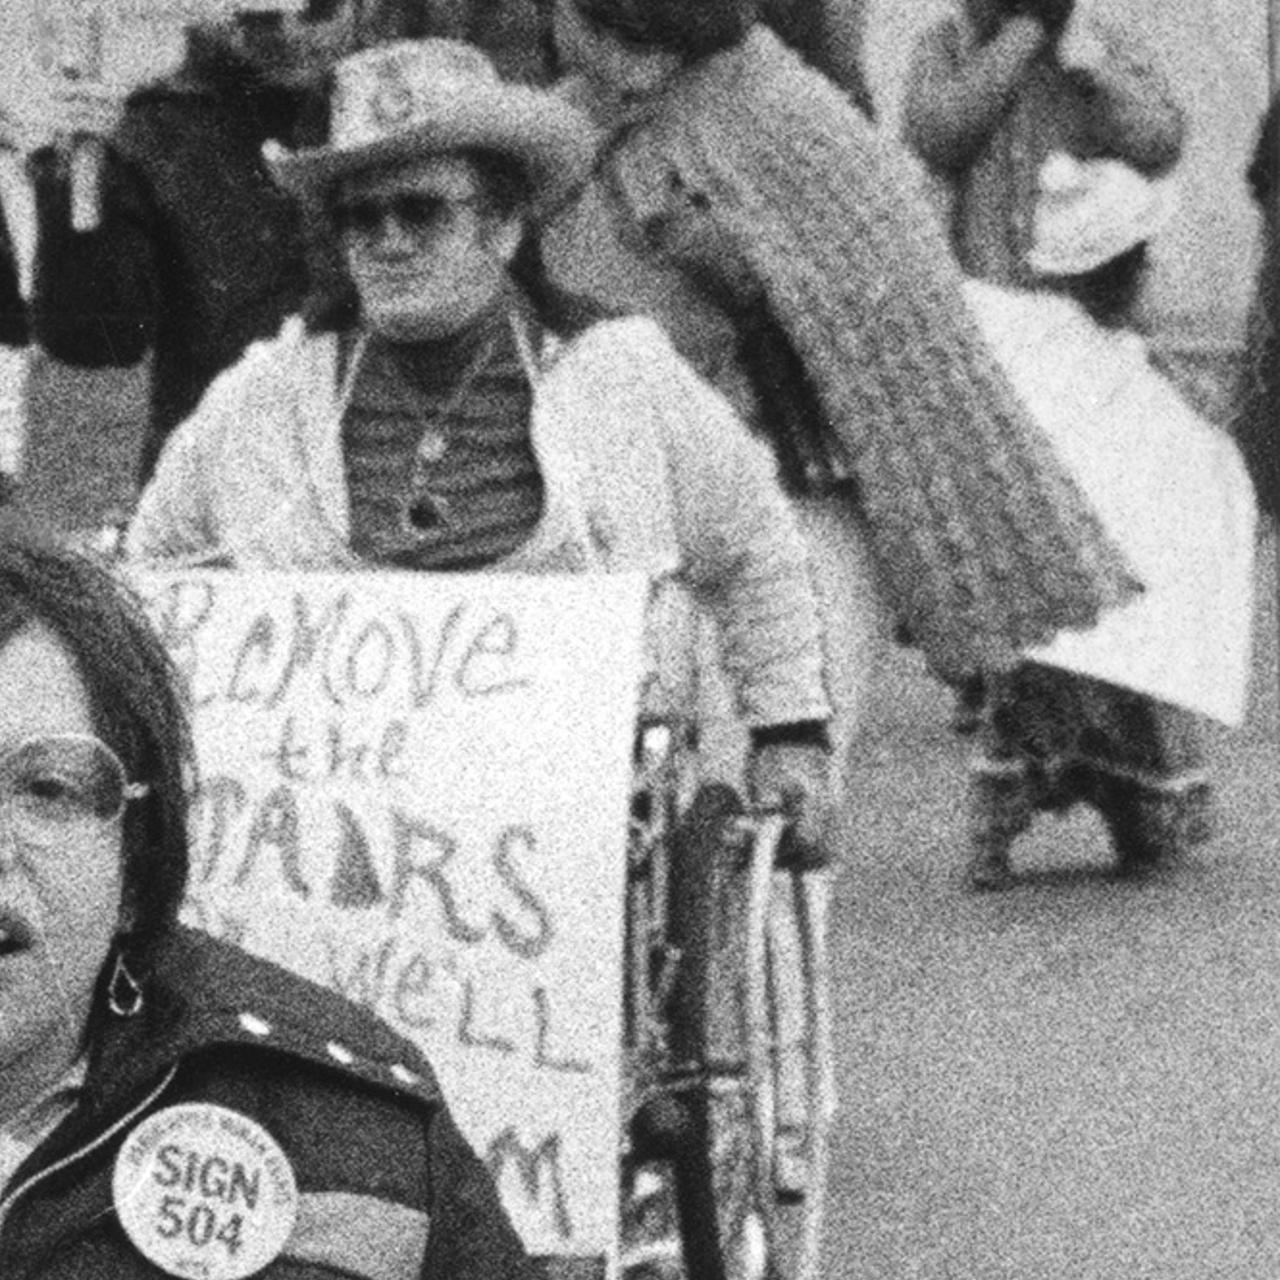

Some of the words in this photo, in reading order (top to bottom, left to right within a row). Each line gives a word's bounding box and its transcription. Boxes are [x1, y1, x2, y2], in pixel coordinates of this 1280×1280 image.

[262, 716, 408, 781] the
[151, 1144, 262, 1211] SIGN
[155, 1194, 244, 1256] 504
